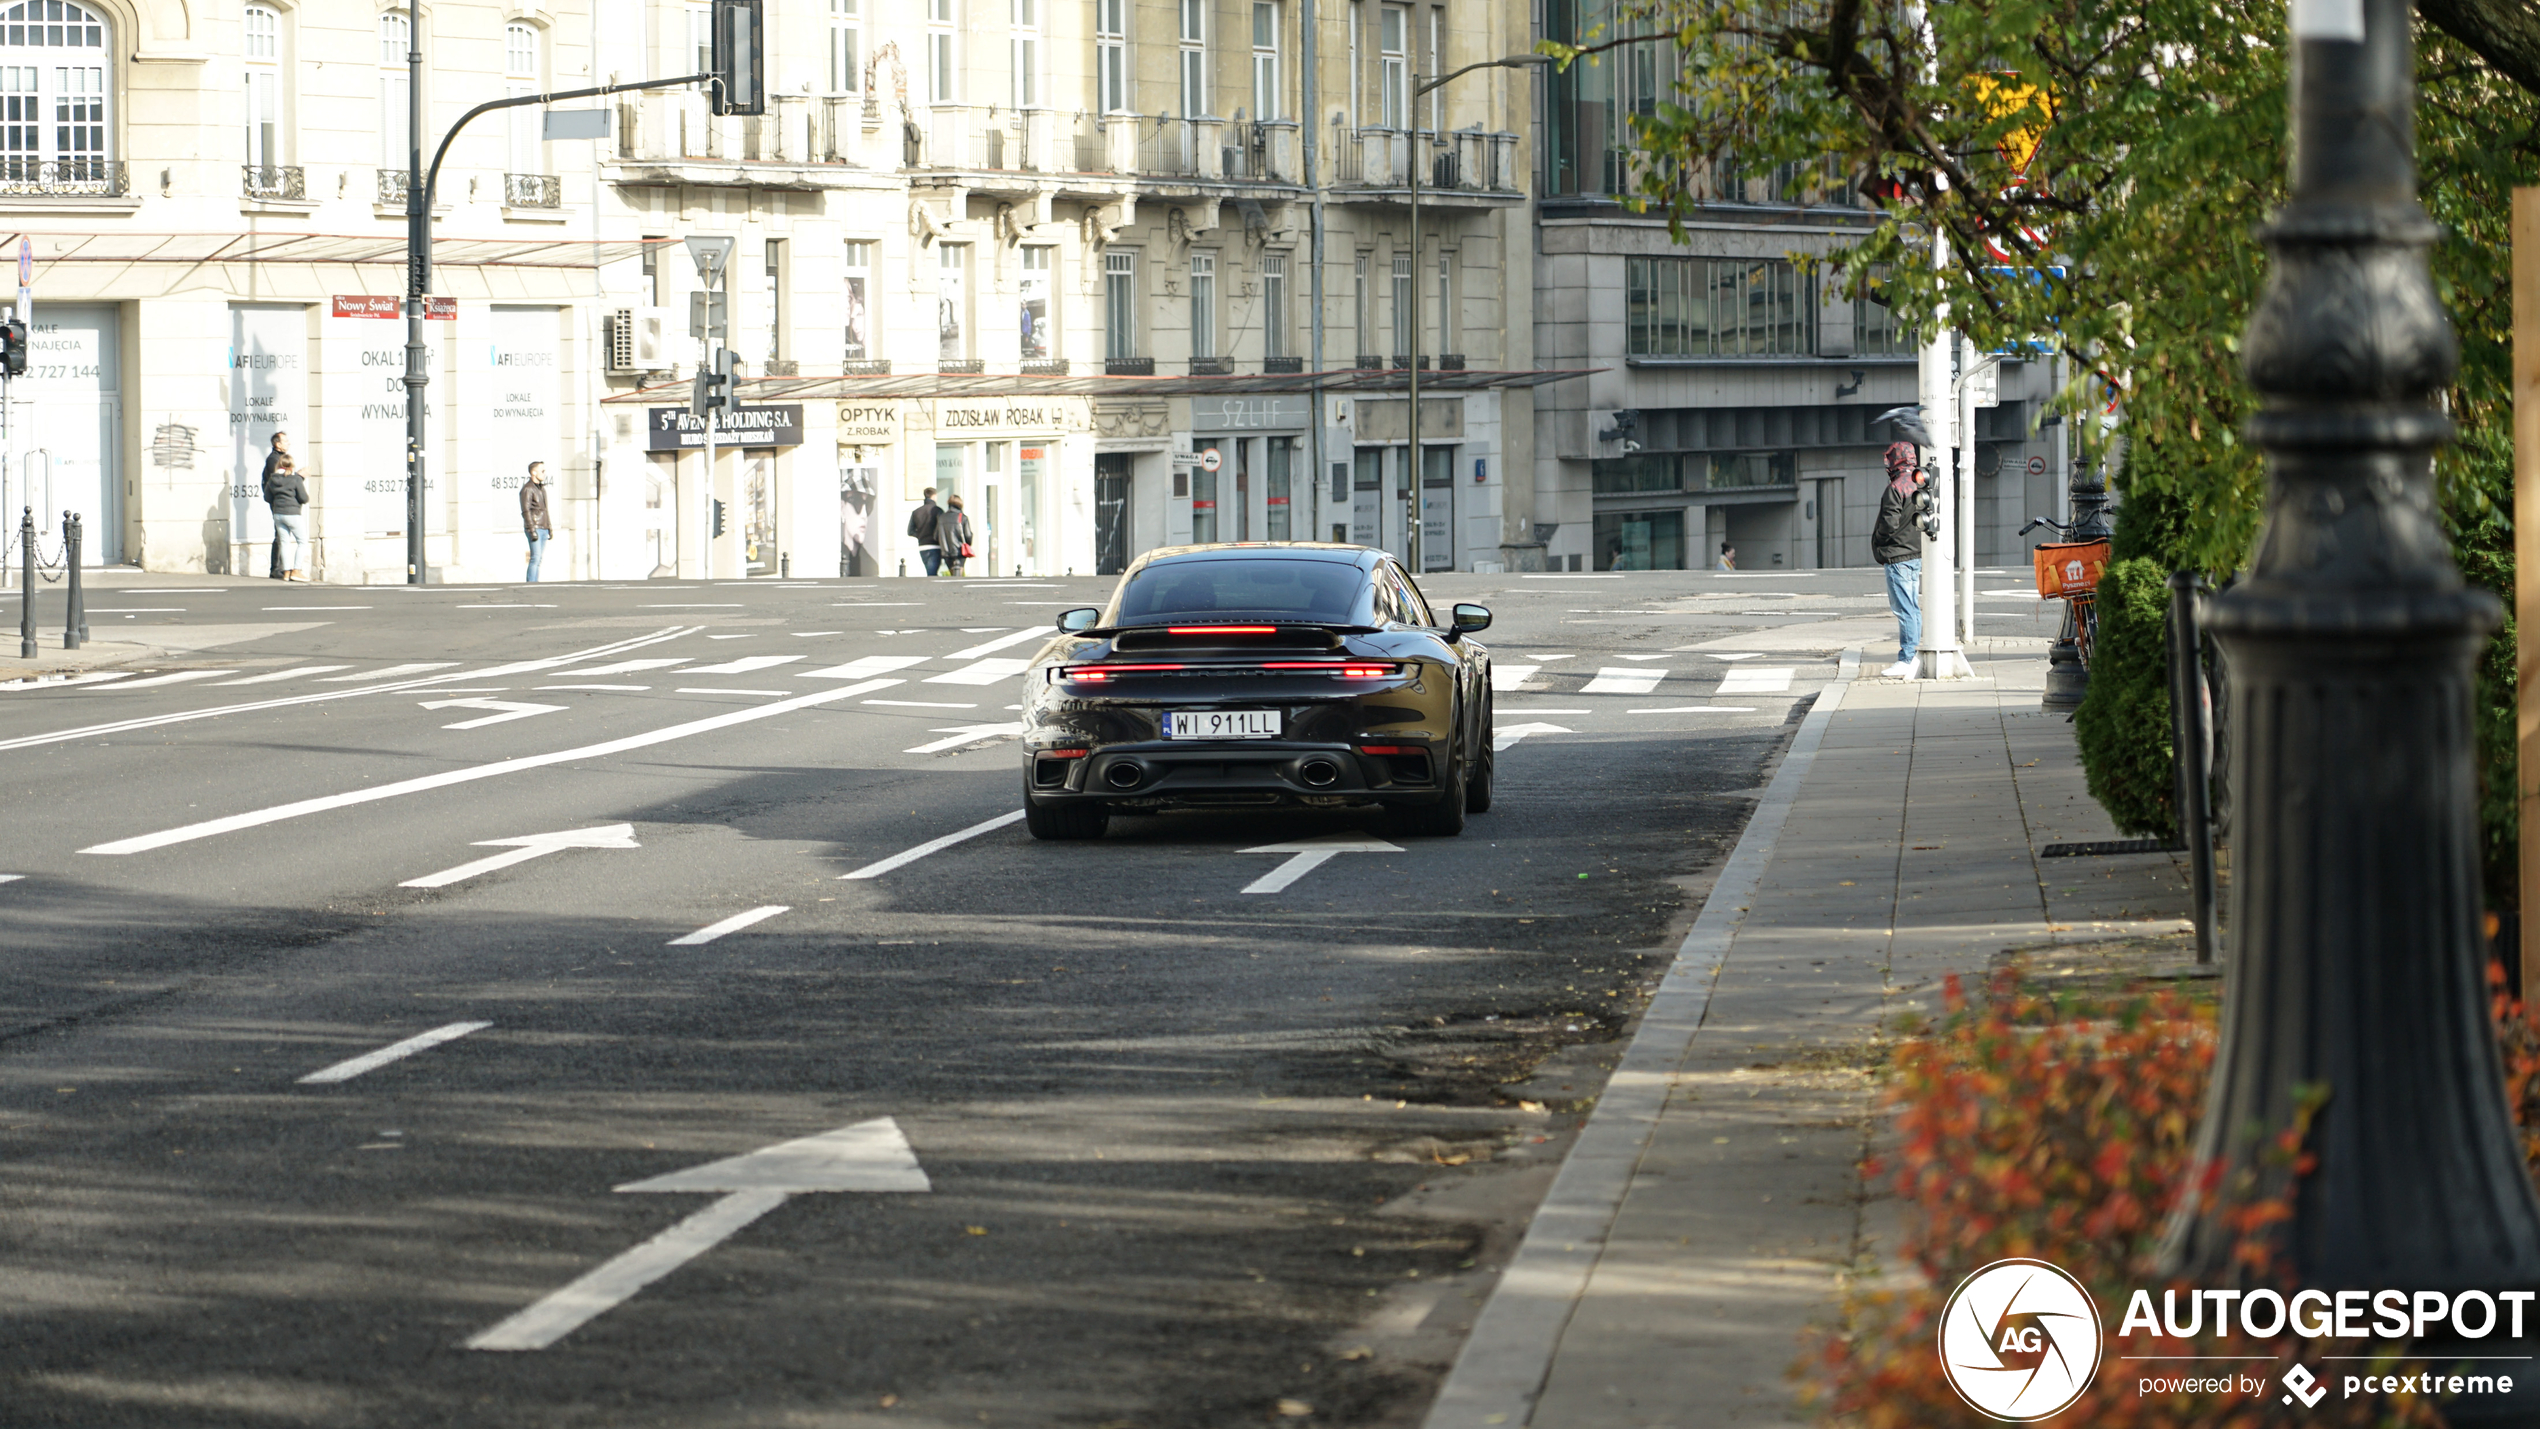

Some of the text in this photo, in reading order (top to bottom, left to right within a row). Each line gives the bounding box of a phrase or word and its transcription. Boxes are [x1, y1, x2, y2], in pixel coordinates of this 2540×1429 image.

[339, 298, 394, 313] Nowy Świat
[235, 354, 298, 369] AFI EUROPE
[38, 365, 66, 379] 727
[72, 365, 100, 379] 144
[387, 377, 405, 392] DO
[245, 397, 274, 407] LOKALE
[506, 393, 531, 403] LOKALE
[231, 412, 288, 425] DO WYNAJĘCIA
[493, 408, 504, 418] DO
[722, 411, 774, 429] HOLDING
[774, 411, 792, 427] S.A.
[840, 408, 895, 422] OPTYK
[946, 408, 1044, 427] ZDZISŁAW ROBAK
[1222, 400, 1280, 427] SZLIF
[847, 427, 891, 436] Z.ROBAK
[379, 480, 396, 493] 532
[503, 477, 519, 489] 532
[241, 485, 260, 498] 532
[1177, 713, 1274, 734] WI 911LL
